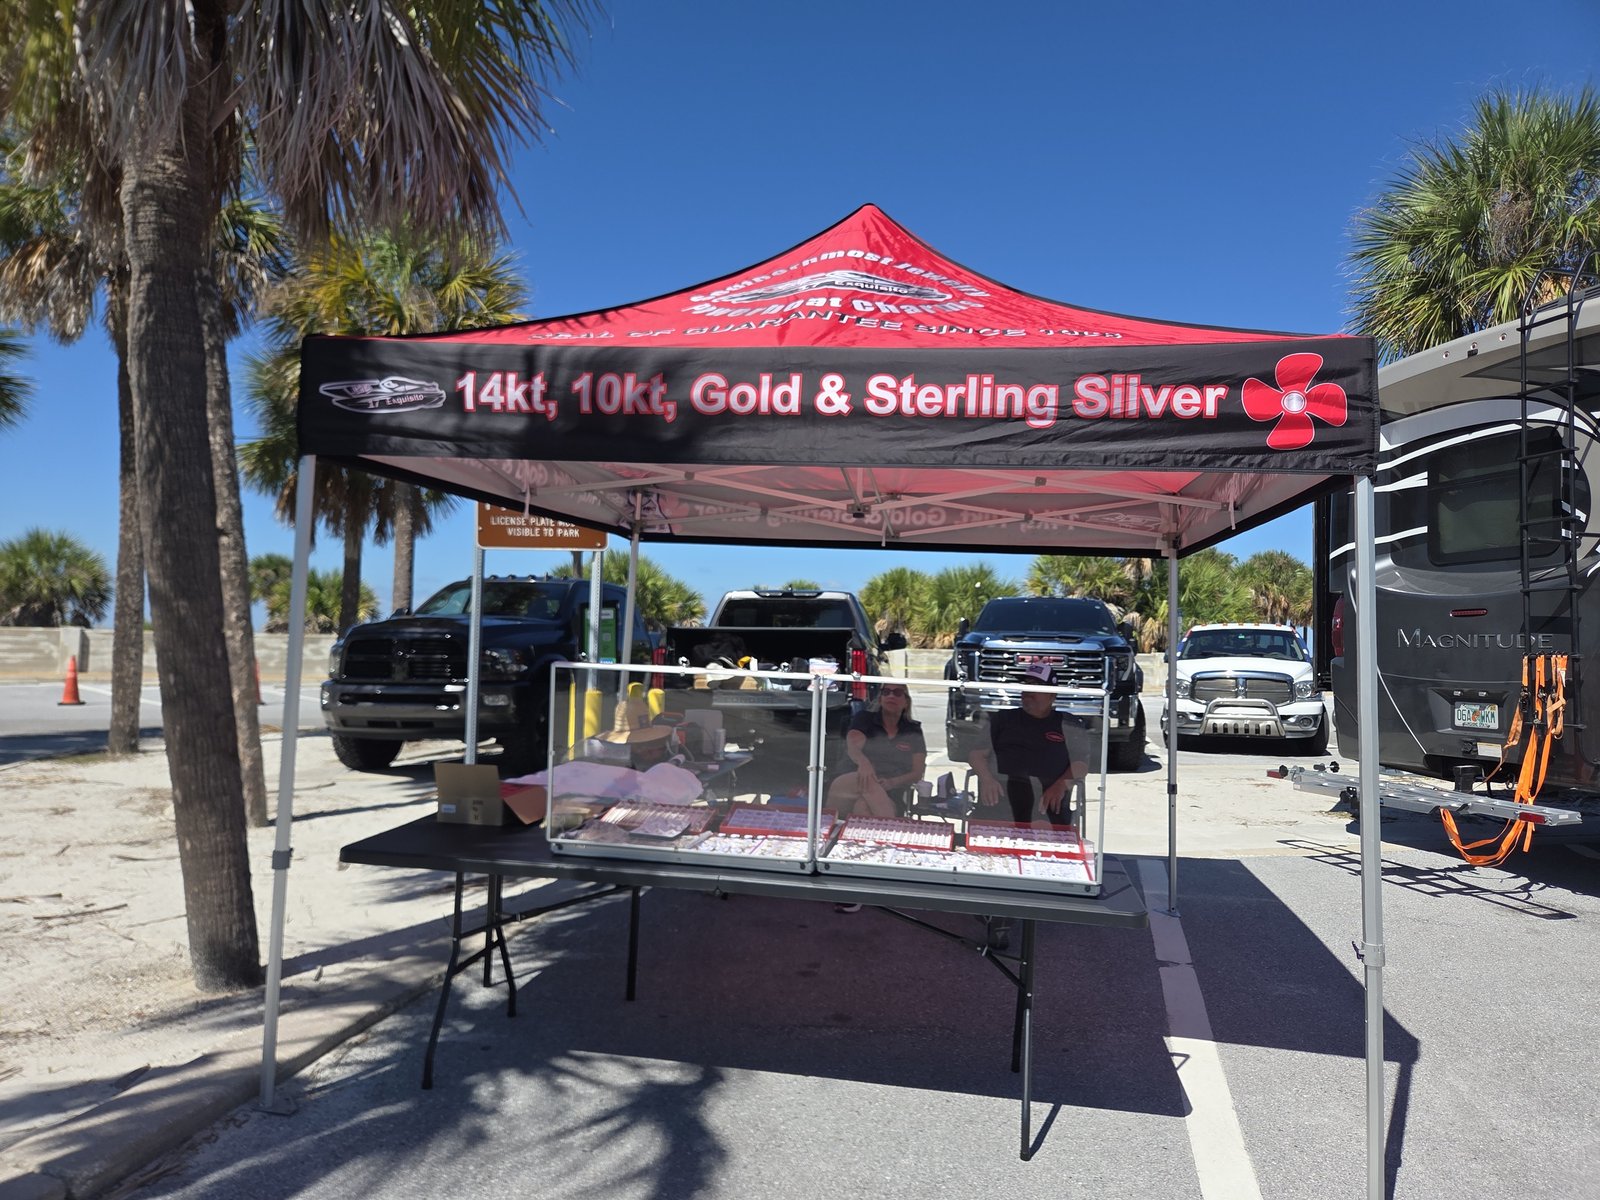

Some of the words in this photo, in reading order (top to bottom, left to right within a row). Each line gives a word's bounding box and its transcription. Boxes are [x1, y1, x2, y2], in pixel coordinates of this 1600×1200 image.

[834, 281, 909, 294] Exquisito
[852, 299, 985, 315] Charms
[683, 310, 904, 335] GUARANTEE
[914, 323, 1026, 337] SINCE
[456, 371, 558, 422] 14kt,
[572, 371, 677, 424] 10kt,
[690, 372, 802, 416] Gold
[815, 373, 854, 416] &
[863, 373, 1059, 428] Sterling
[1072, 375, 1226, 420] Silver
[490, 516, 527, 526] LICENSE
[530, 517, 555, 527] PLATE
[507, 527, 540, 537] VISIBLE
[543, 527, 554, 537] TO
[557, 528, 580, 538] PARK
